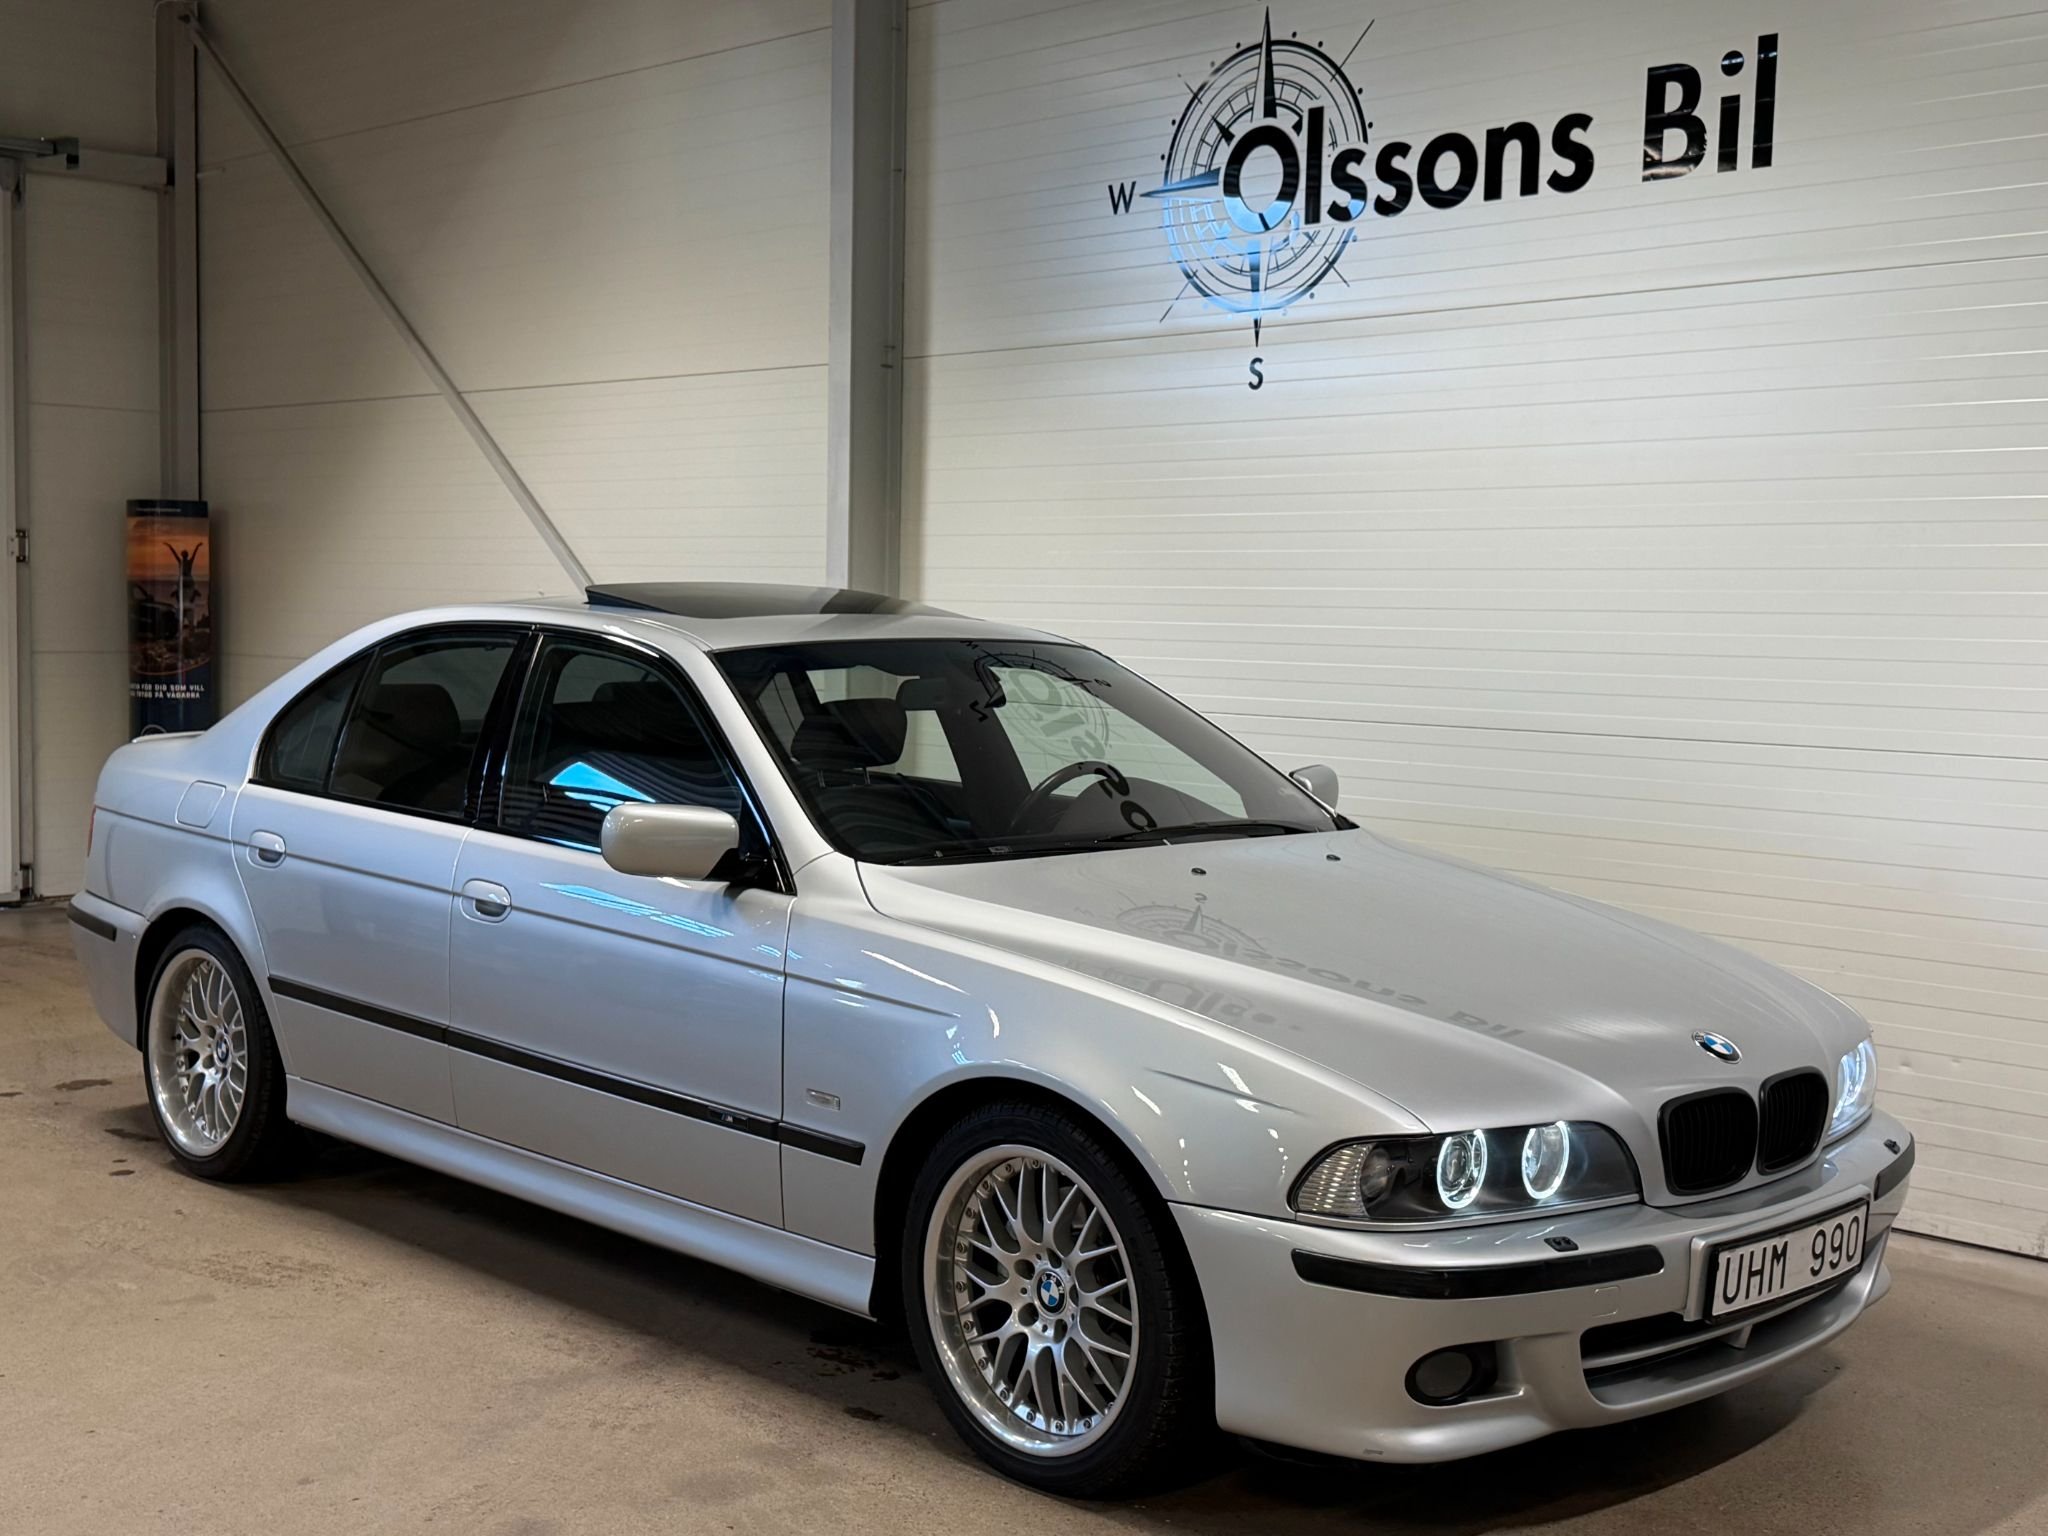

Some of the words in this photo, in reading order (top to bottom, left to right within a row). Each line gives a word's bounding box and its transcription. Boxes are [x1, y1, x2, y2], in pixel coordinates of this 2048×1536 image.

[1222, 104, 1594, 233] Olssons
[1642, 33, 1779, 182] Bil
[1108, 180, 1137, 215] W
[1248, 357, 1264, 390] S
[1722, 1240, 1789, 1305] UHM
[1810, 1215, 1860, 1277] 990
